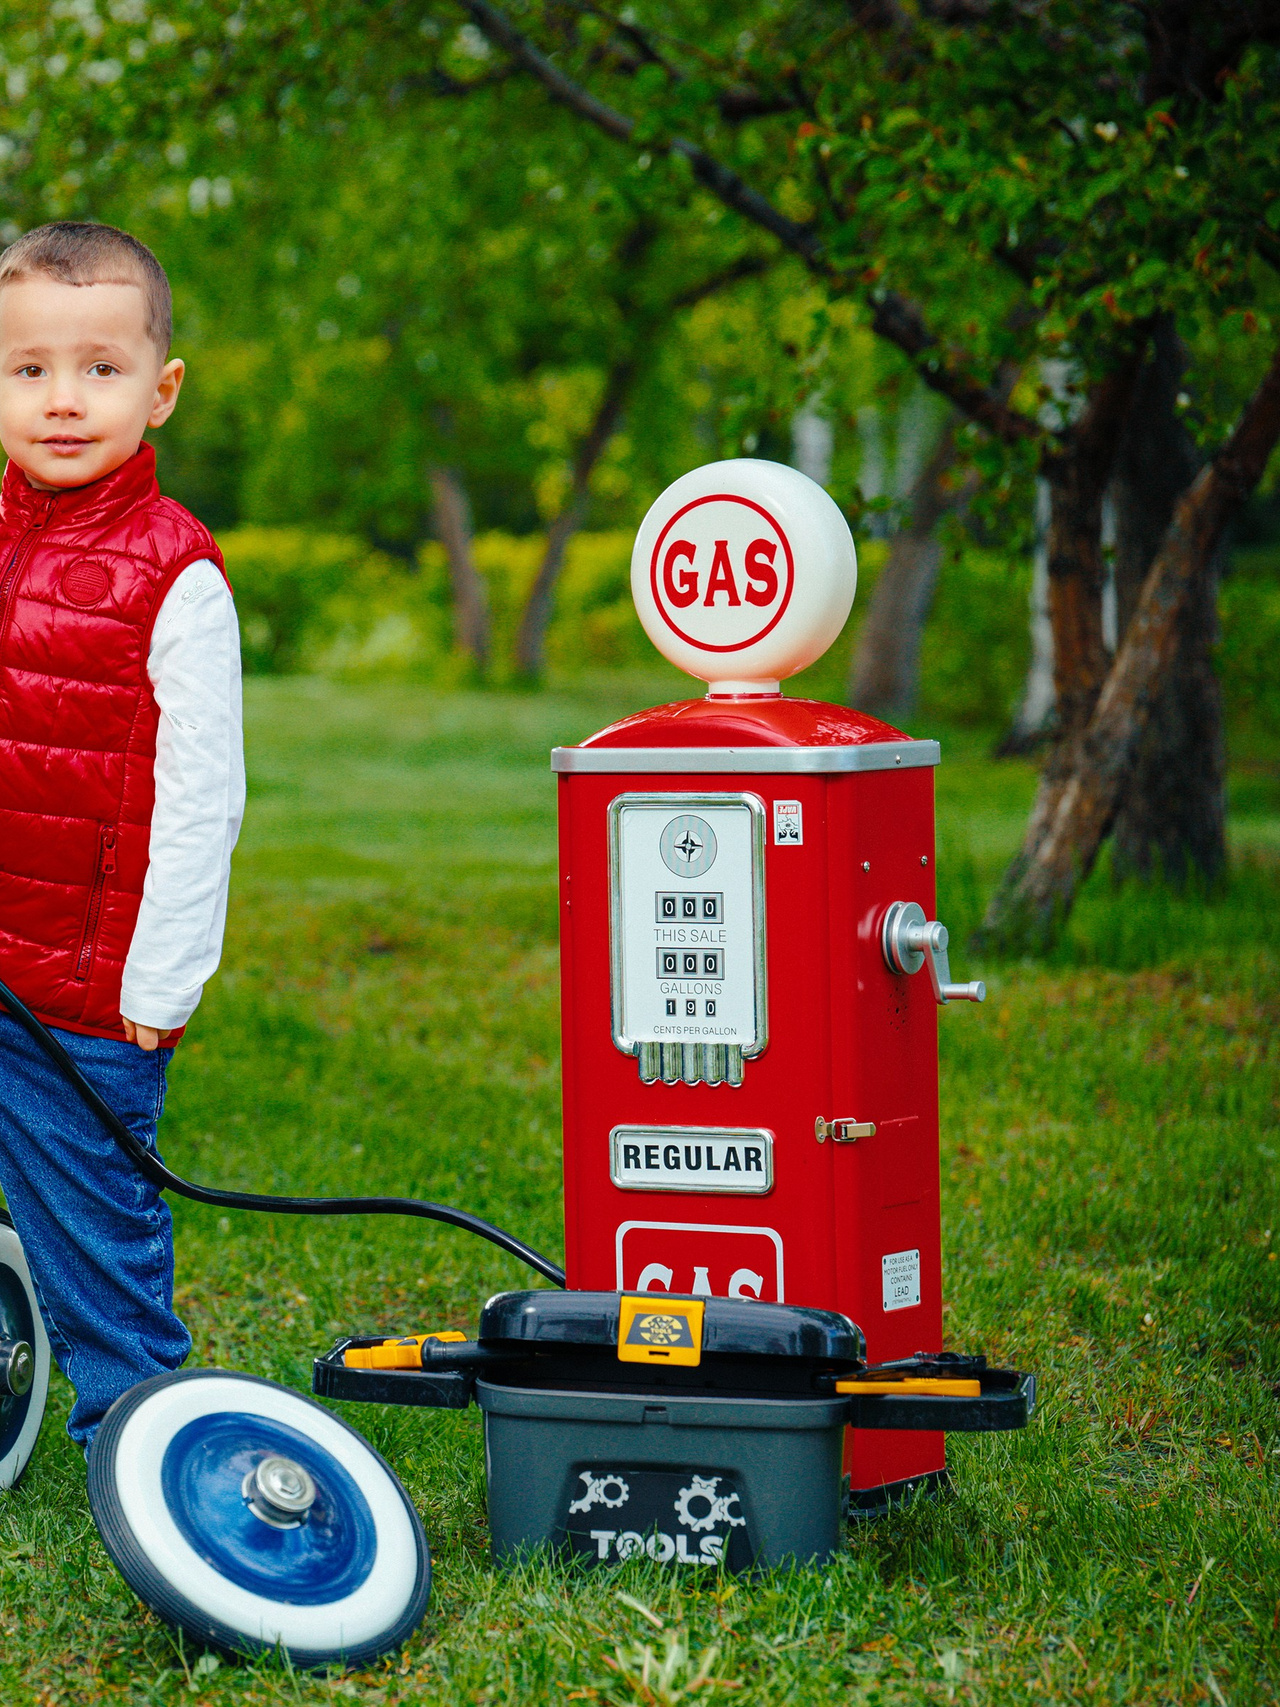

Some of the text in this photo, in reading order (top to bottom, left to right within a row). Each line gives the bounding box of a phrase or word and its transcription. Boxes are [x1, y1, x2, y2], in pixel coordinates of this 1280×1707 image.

[663, 538, 779, 608] GAS
[653, 929, 727, 943] THIS SALE
[660, 982, 723, 995] GALLONS
[653, 1026, 737, 1036] CENTS PER GALLON
[623, 1144, 763, 1172] REGULAR
[890, 1274, 913, 1284] CONTAINS
[894, 1285, 910, 1297] LEAD
[590, 1530, 724, 1565] TOOLS
